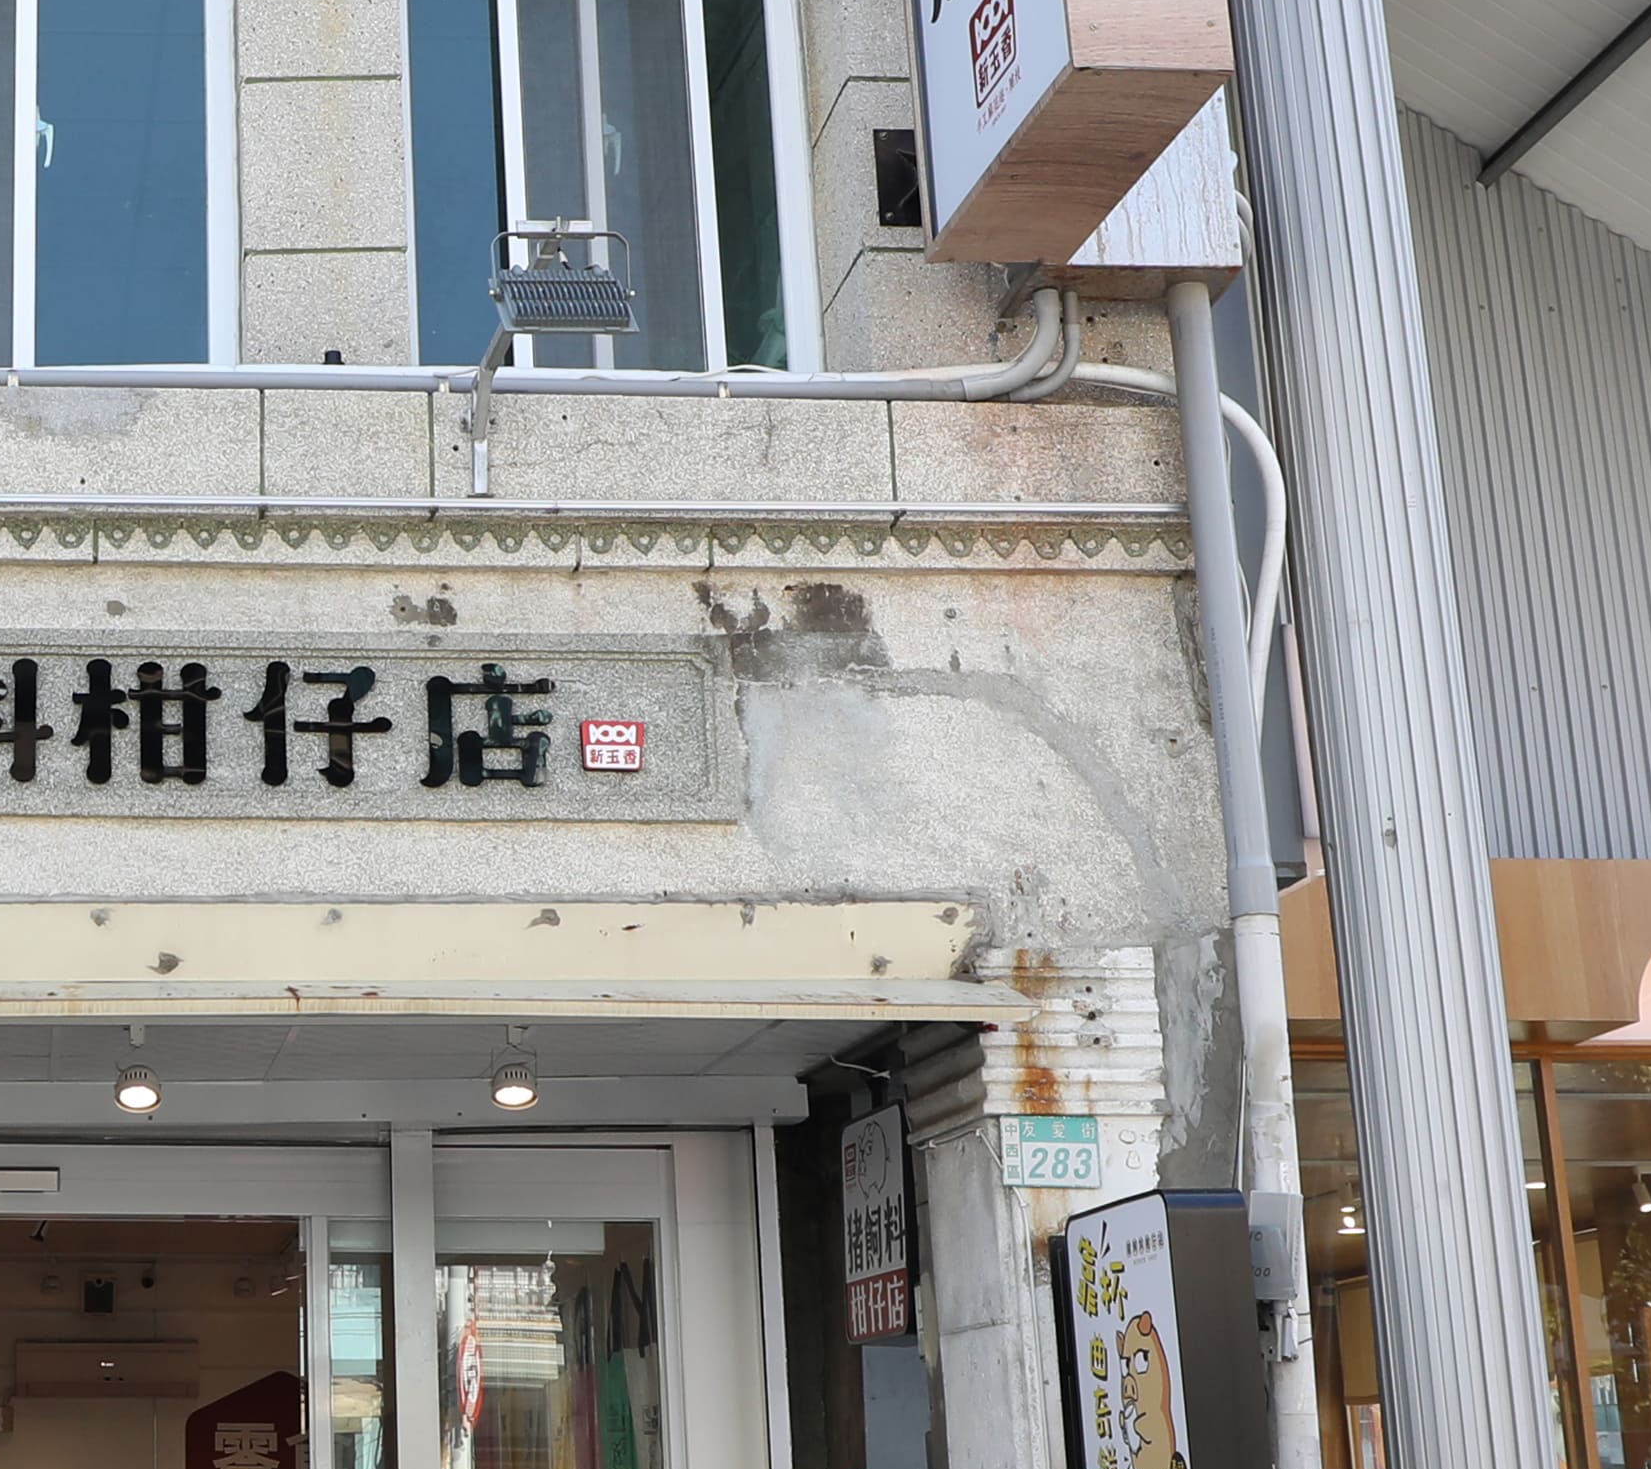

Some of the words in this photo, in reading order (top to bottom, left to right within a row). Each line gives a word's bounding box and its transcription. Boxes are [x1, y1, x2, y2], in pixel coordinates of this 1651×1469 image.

[590, 749, 637, 764] 新玉香
[1022, 1121, 1096, 1139] 友愛街
[1005, 1123, 1020, 1180] 中西區
[1028, 1147, 1093, 1180] 283
[850, 1274, 905, 1337] 柑仔店
